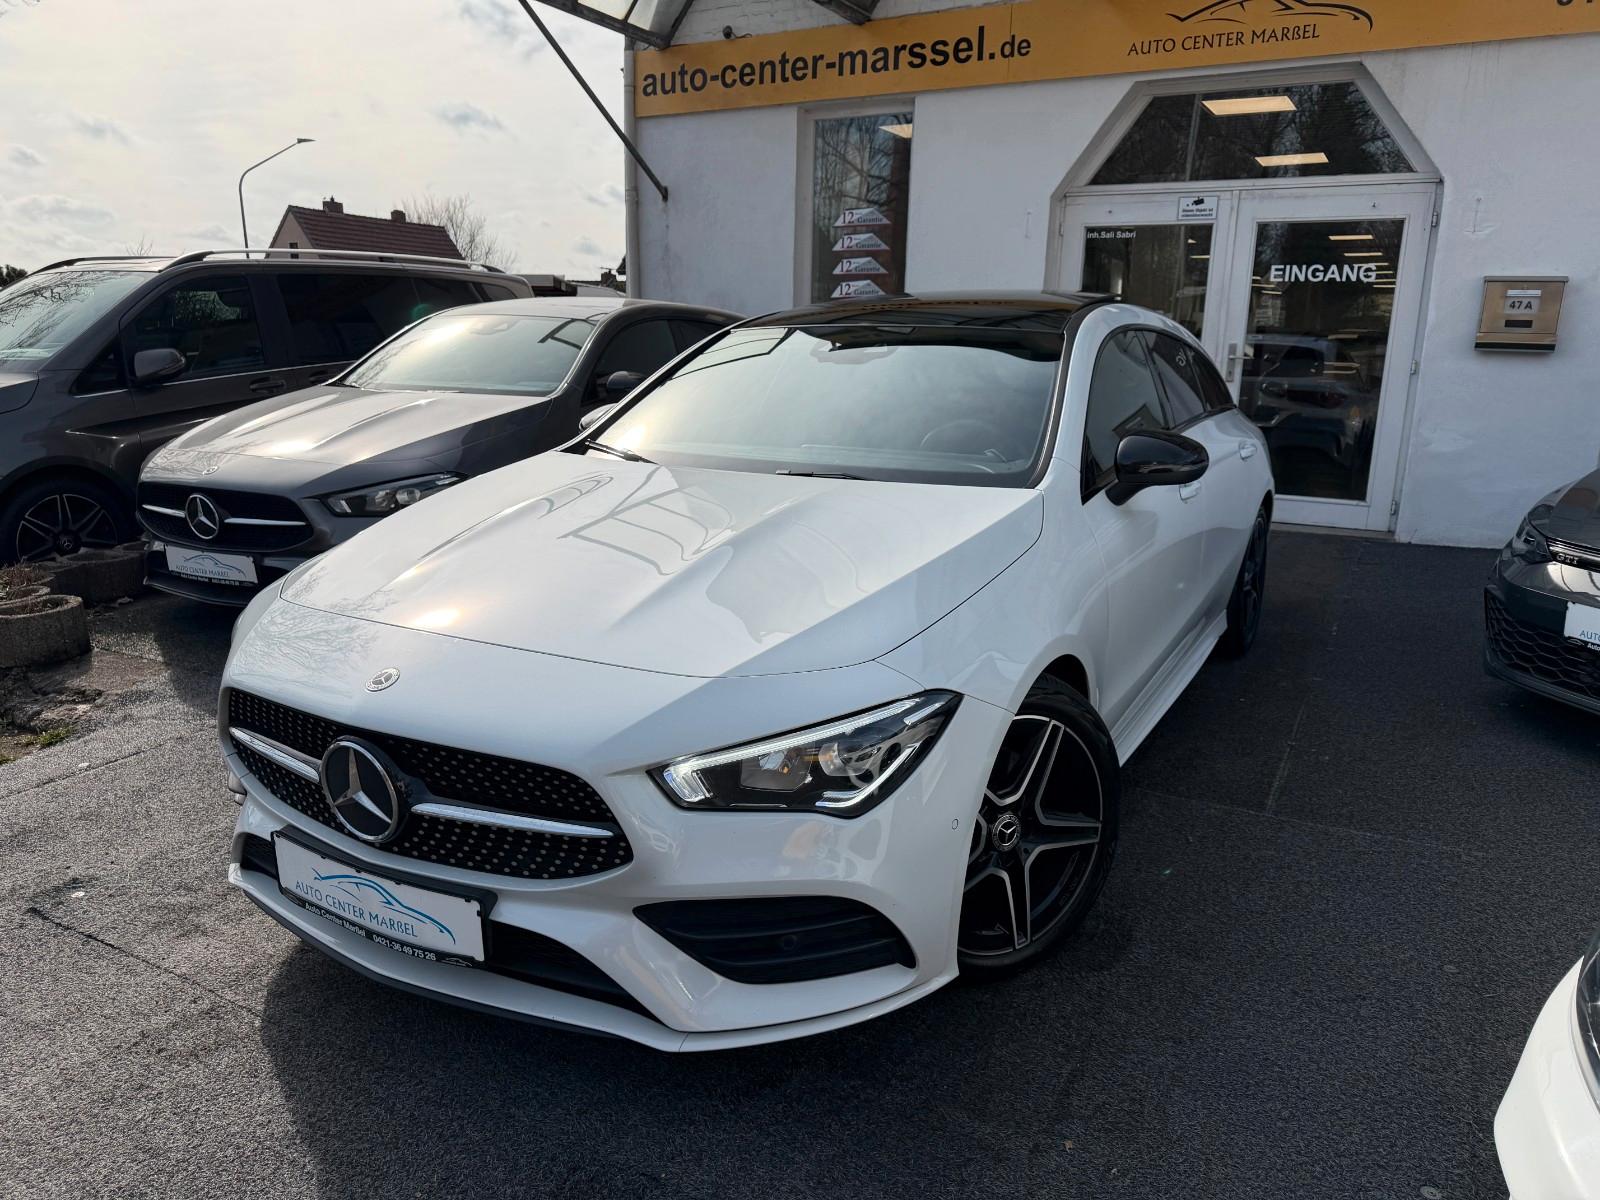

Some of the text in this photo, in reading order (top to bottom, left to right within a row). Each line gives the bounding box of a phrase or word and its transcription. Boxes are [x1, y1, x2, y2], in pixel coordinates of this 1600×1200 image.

[1127, 37, 1176, 56] AUTO
[1181, 31, 1245, 51] CENTER
[641, 26, 1032, 98] auto-center-marssel.de
[841, 211, 884, 224] 12 Garantie
[840, 236, 854, 249] 12
[839, 260, 853, 273] 12
[1269, 263, 1378, 283] EINGANG
[838, 283, 852, 296] 12
[1509, 301, 1532, 310] 47 A
[1556, 553, 1579, 565] GTI
[295, 879, 323, 902] AUTO
[325, 894, 366, 921] CENTER
[305, 902, 321, 915] Auto
[372, 934, 402, 952] 0421-36
[402, 945, 413, 955] 49
[413, 948, 424, 958] 75
[425, 951, 437, 961] 26
